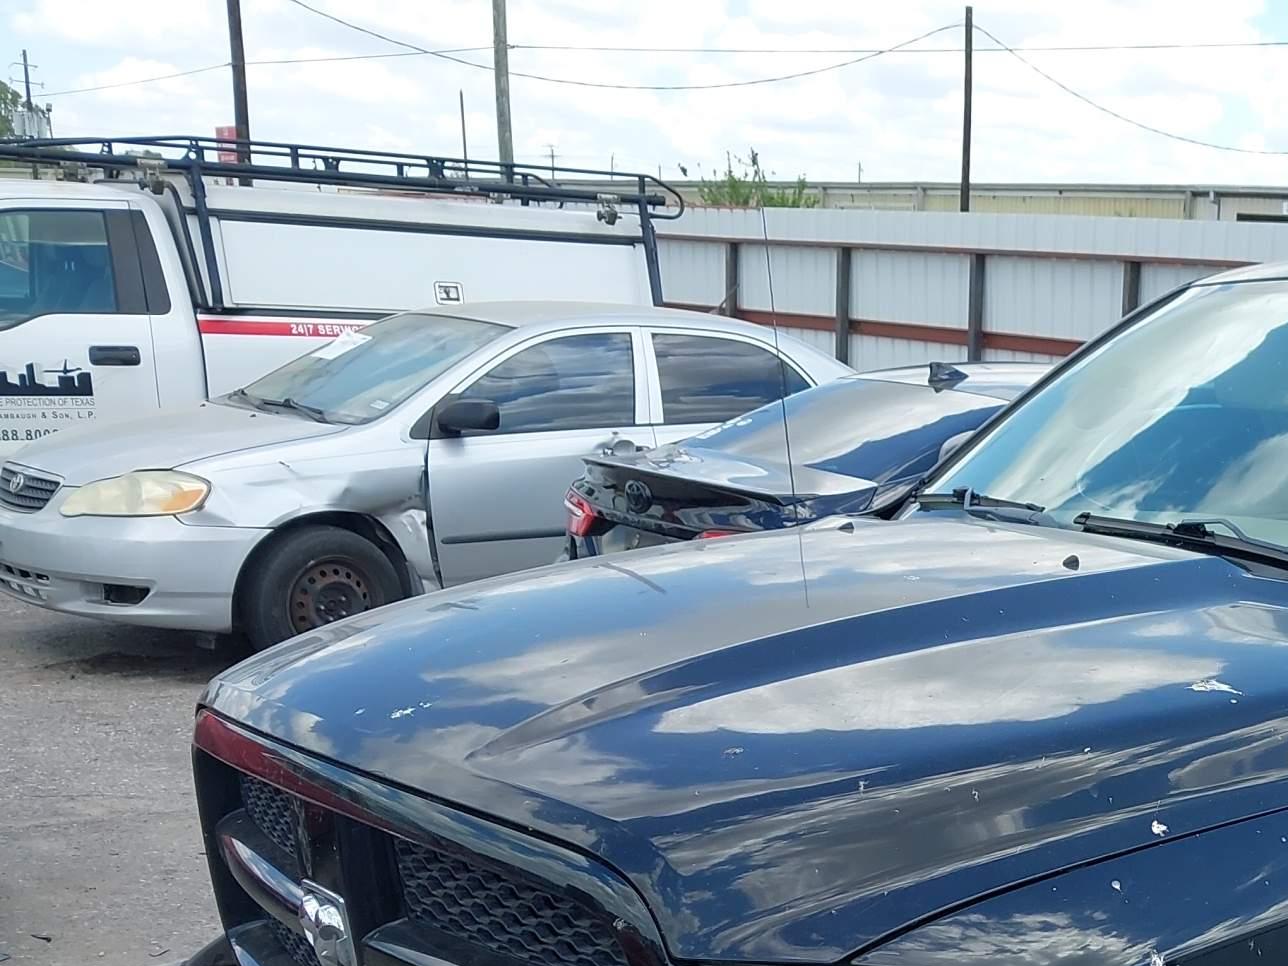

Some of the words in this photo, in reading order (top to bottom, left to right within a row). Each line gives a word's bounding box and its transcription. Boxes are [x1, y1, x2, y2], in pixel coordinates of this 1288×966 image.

[5, 397, 56, 407] PROTECTION
[58, 397, 68, 407] OF
[71, 397, 96, 407] TEXAS
[41, 411, 47, 419] &
